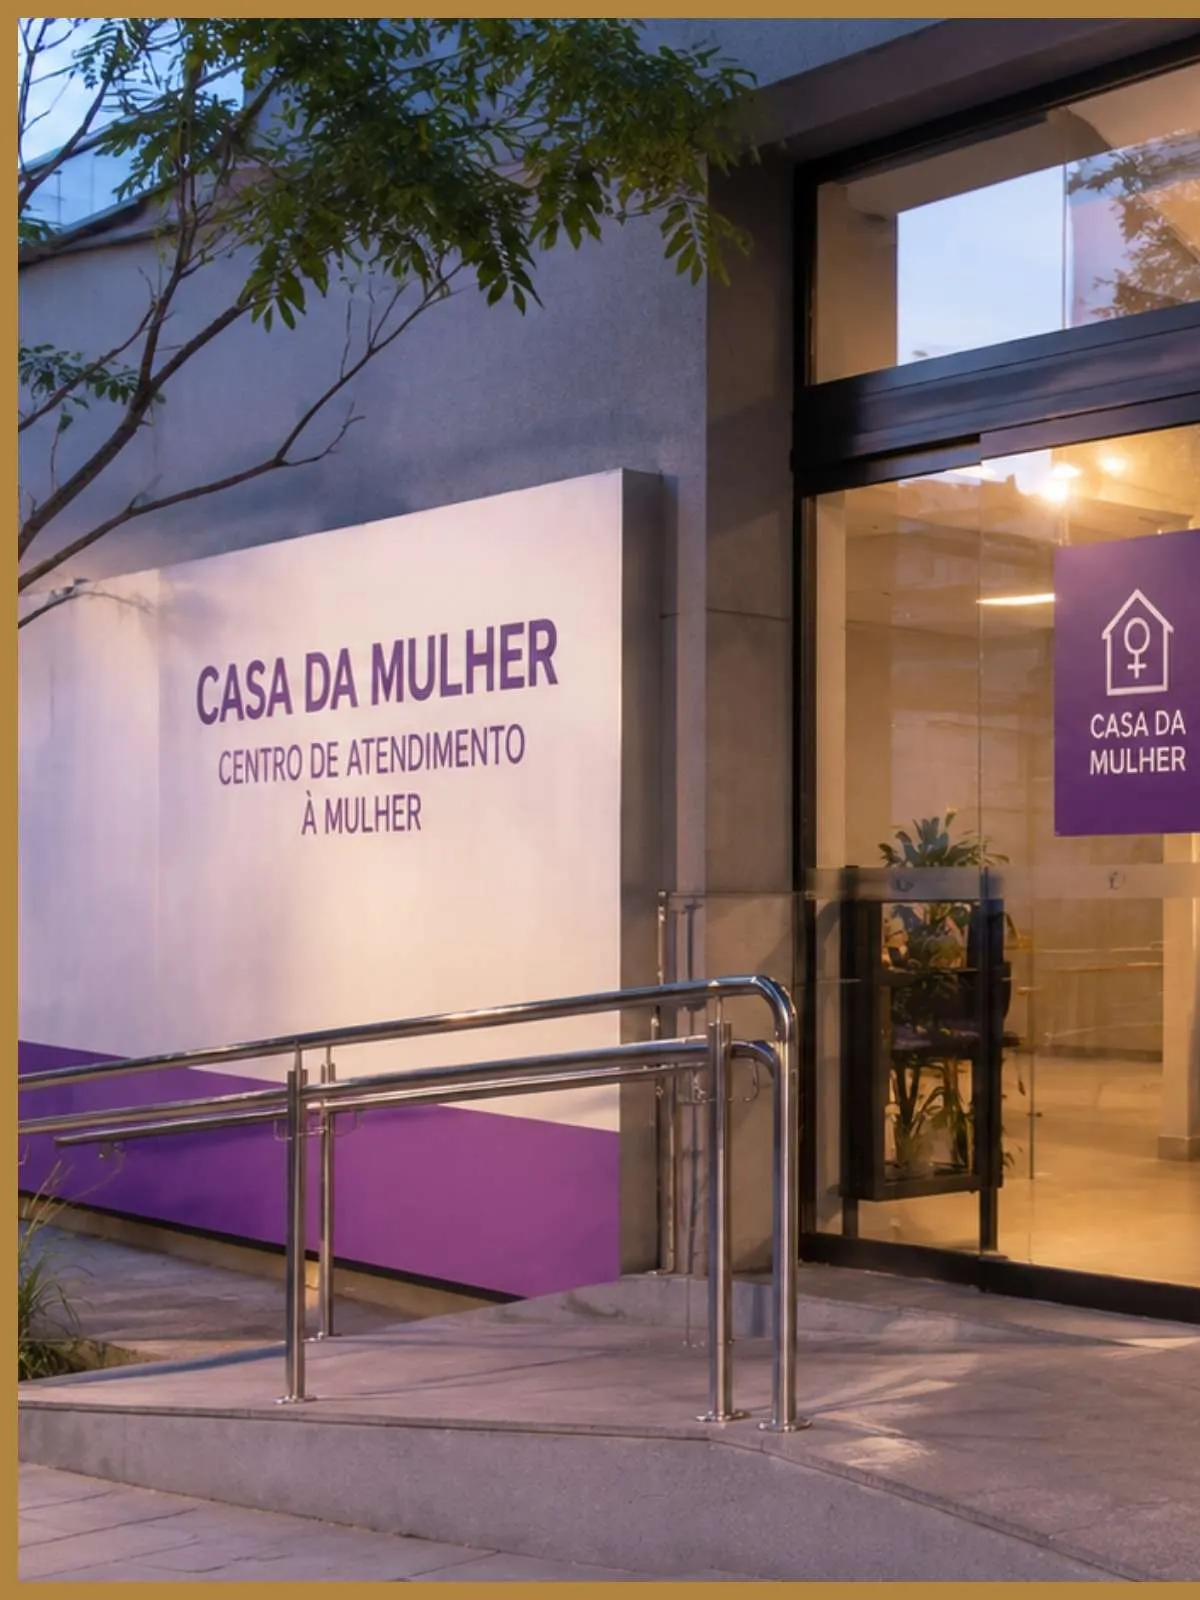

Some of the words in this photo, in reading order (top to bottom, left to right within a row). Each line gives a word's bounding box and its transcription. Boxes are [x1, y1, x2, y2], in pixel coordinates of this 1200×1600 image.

[196, 656, 293, 725] CASA
[305, 647, 359, 713] DA
[371, 618, 559, 706] MULHER
[1090, 711, 1149, 739] CASA
[1155, 709, 1187, 736] DA
[218, 743, 302, 786] CENTRO
[310, 741, 339, 779] DE
[346, 723, 525, 777] ATENDIMENTO
[1089, 746, 1187, 775] MULHER
[301, 790, 317, 835] À
[325, 793, 422, 835] MULHER
